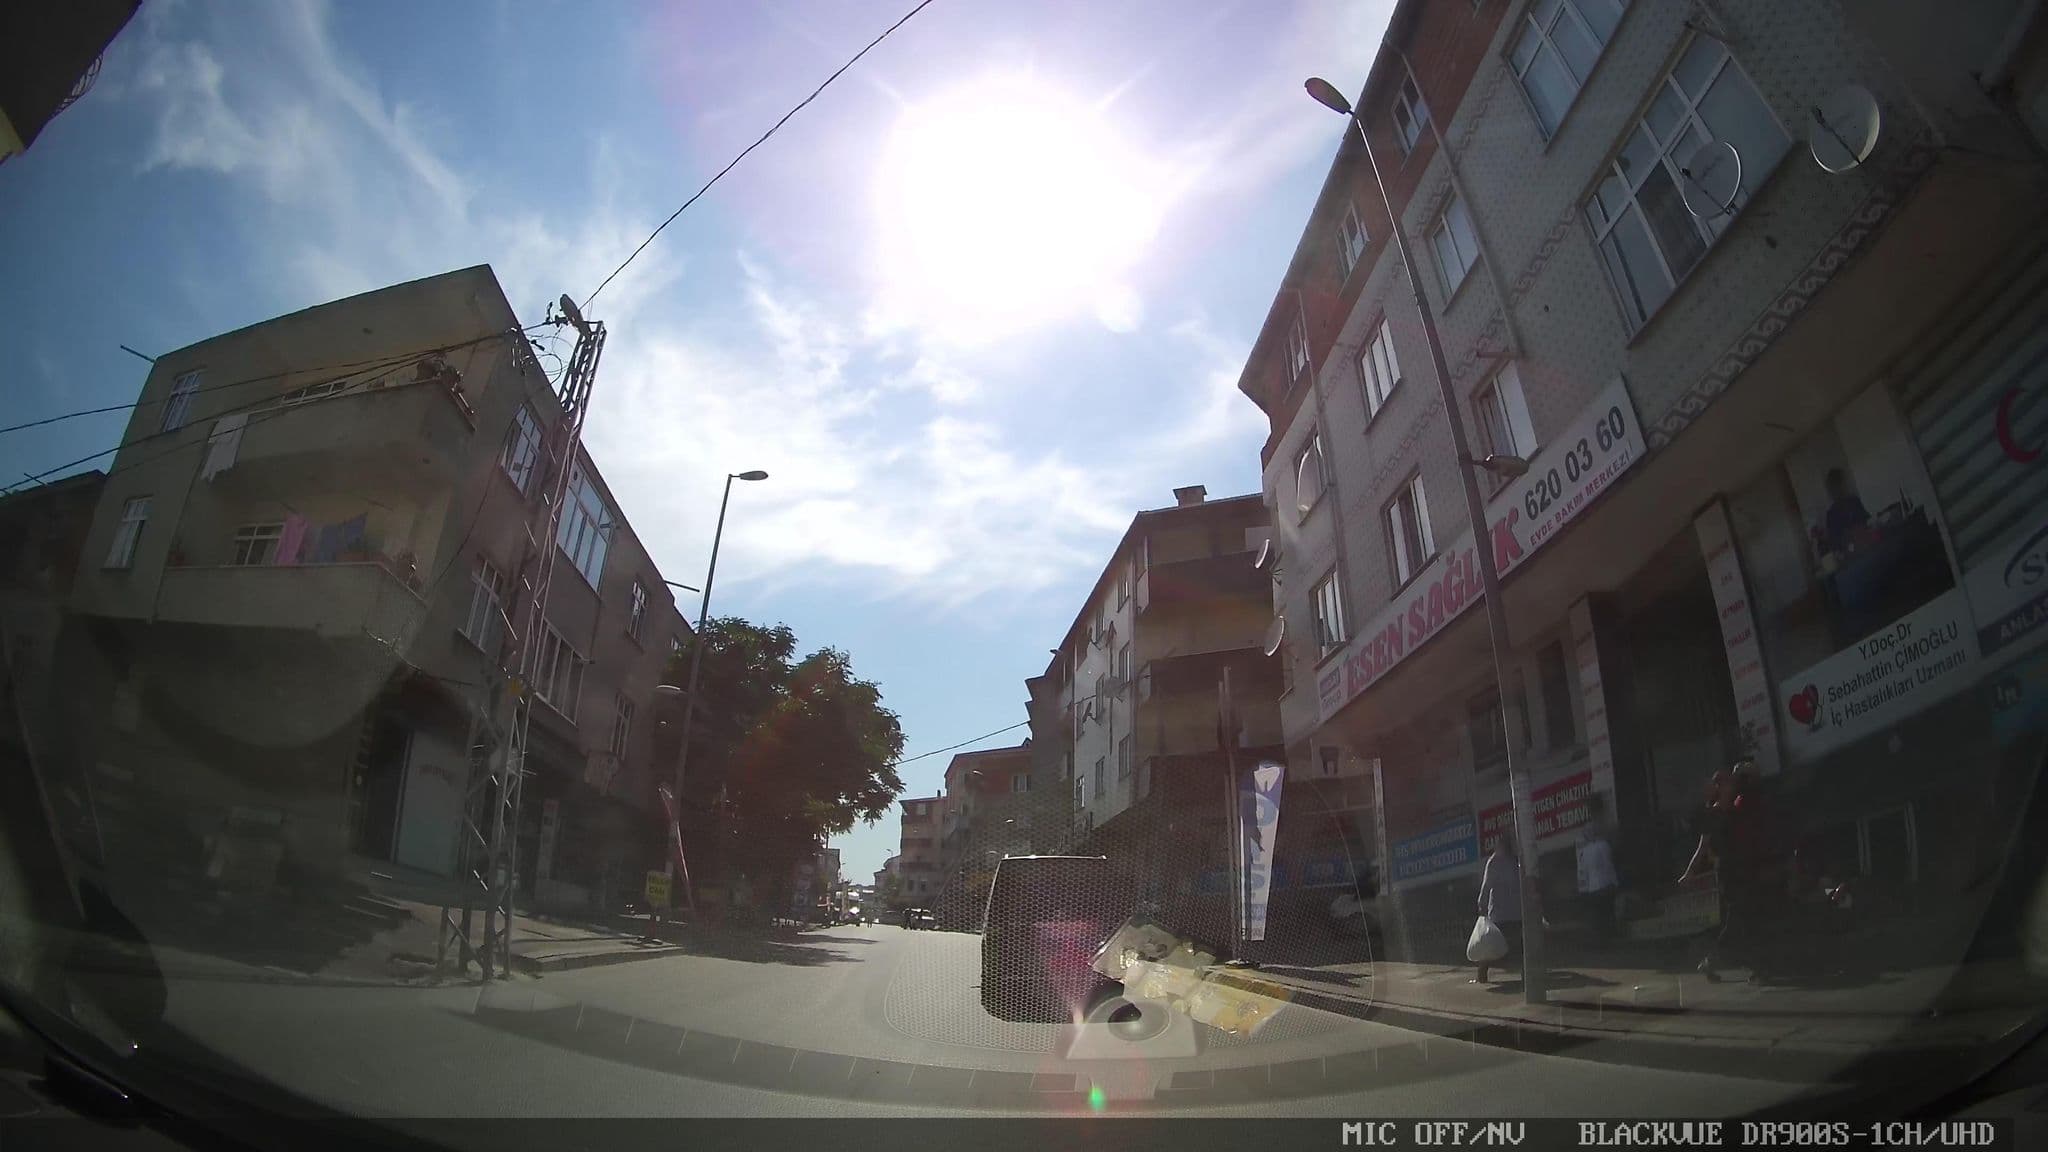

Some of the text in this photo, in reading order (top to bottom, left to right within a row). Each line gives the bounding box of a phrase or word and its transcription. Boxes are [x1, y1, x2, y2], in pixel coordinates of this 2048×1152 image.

[1525, 405, 1625, 520] 620 03 60
[1530, 519, 1553, 546] EVDE
[1555, 492, 1585, 522] BAKIM
[1347, 506, 1523, 702] ESEN SAĞLK
[1827, 619, 1958, 703] Sebahattin ÇİMOĞLU
[1844, 675, 1914, 720] Hastalıkları
